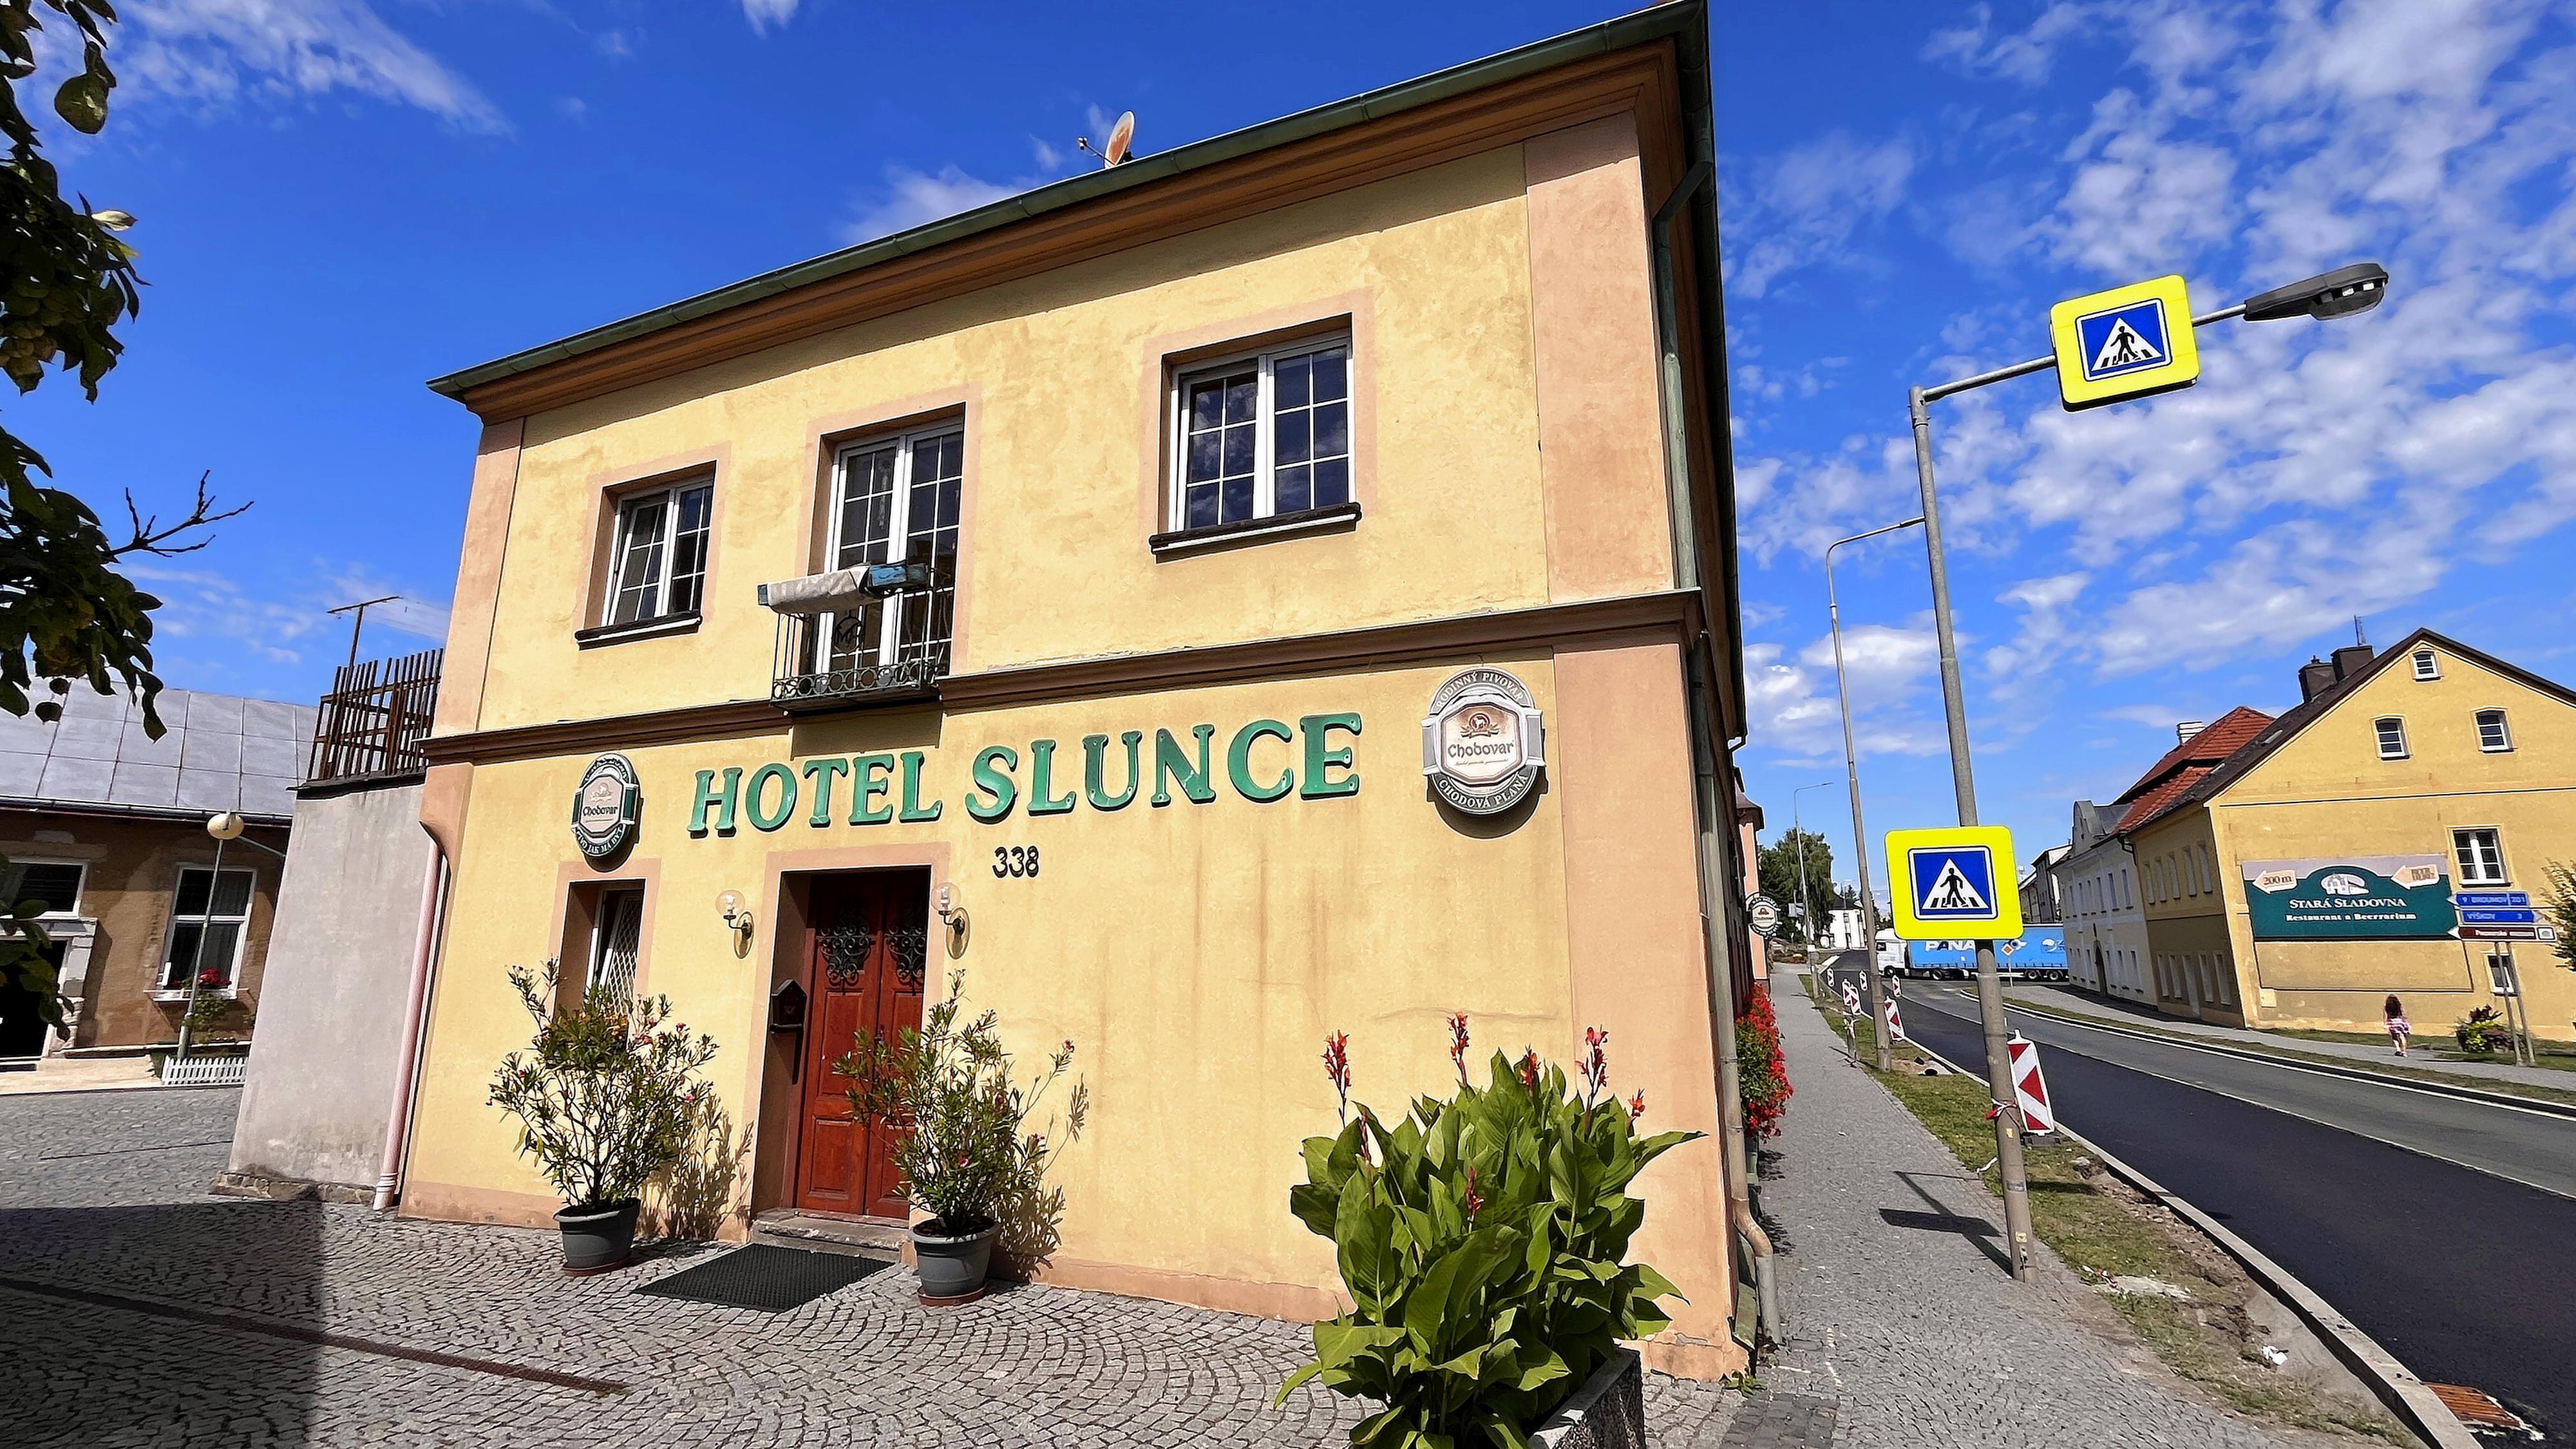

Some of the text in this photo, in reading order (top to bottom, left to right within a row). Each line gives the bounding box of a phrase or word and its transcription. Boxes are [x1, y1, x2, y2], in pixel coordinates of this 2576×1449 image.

[1437, 672, 1524, 708] RODINNÝ PIVOVAR
[687, 712, 1363, 838] HOTEL SLUNCE
[1439, 774, 1529, 808] CHODOVÁ PLANÁ
[992, 844, 1041, 878] 338
[2264, 876, 2280, 886] 200
[2289, 898, 2407, 909] STARÁ SLADOVNA
